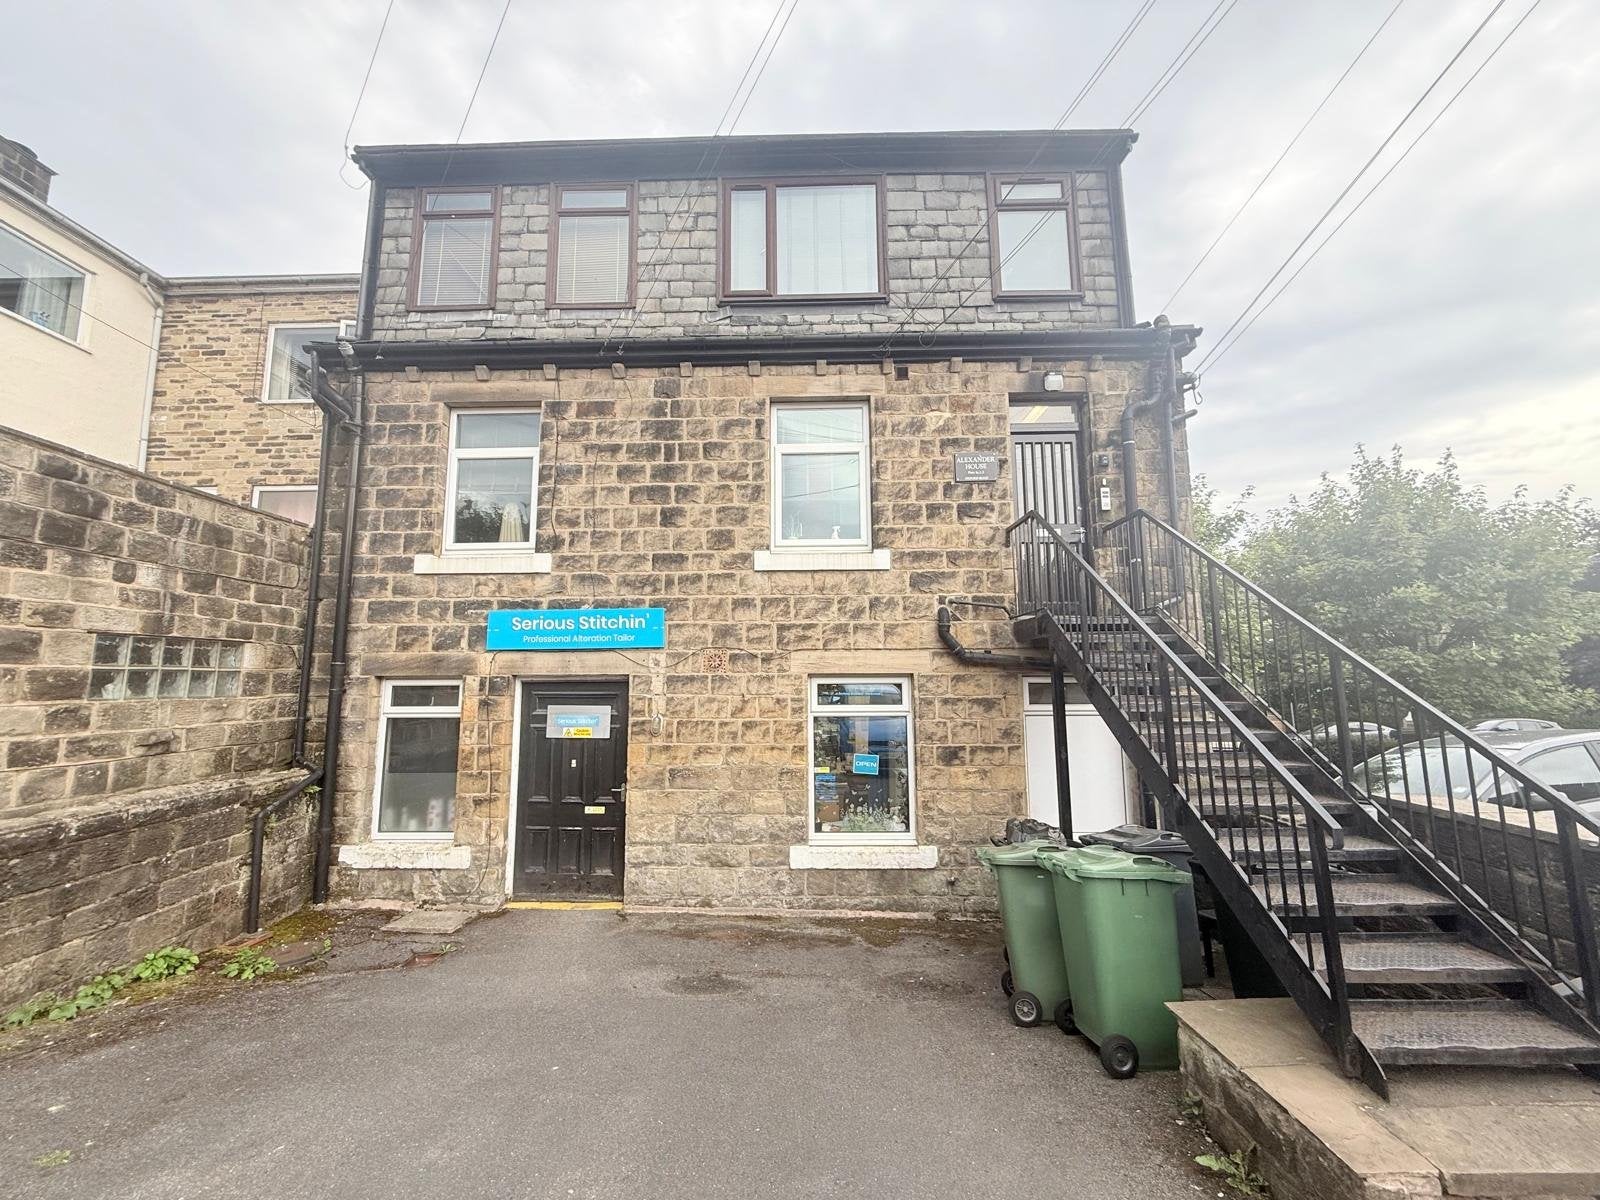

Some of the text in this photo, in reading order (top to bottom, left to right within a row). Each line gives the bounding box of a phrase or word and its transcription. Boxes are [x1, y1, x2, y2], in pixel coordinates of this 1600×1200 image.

[512, 615, 575, 631] Serious
[523, 634, 635, 643] Professional Alteration Tailor
